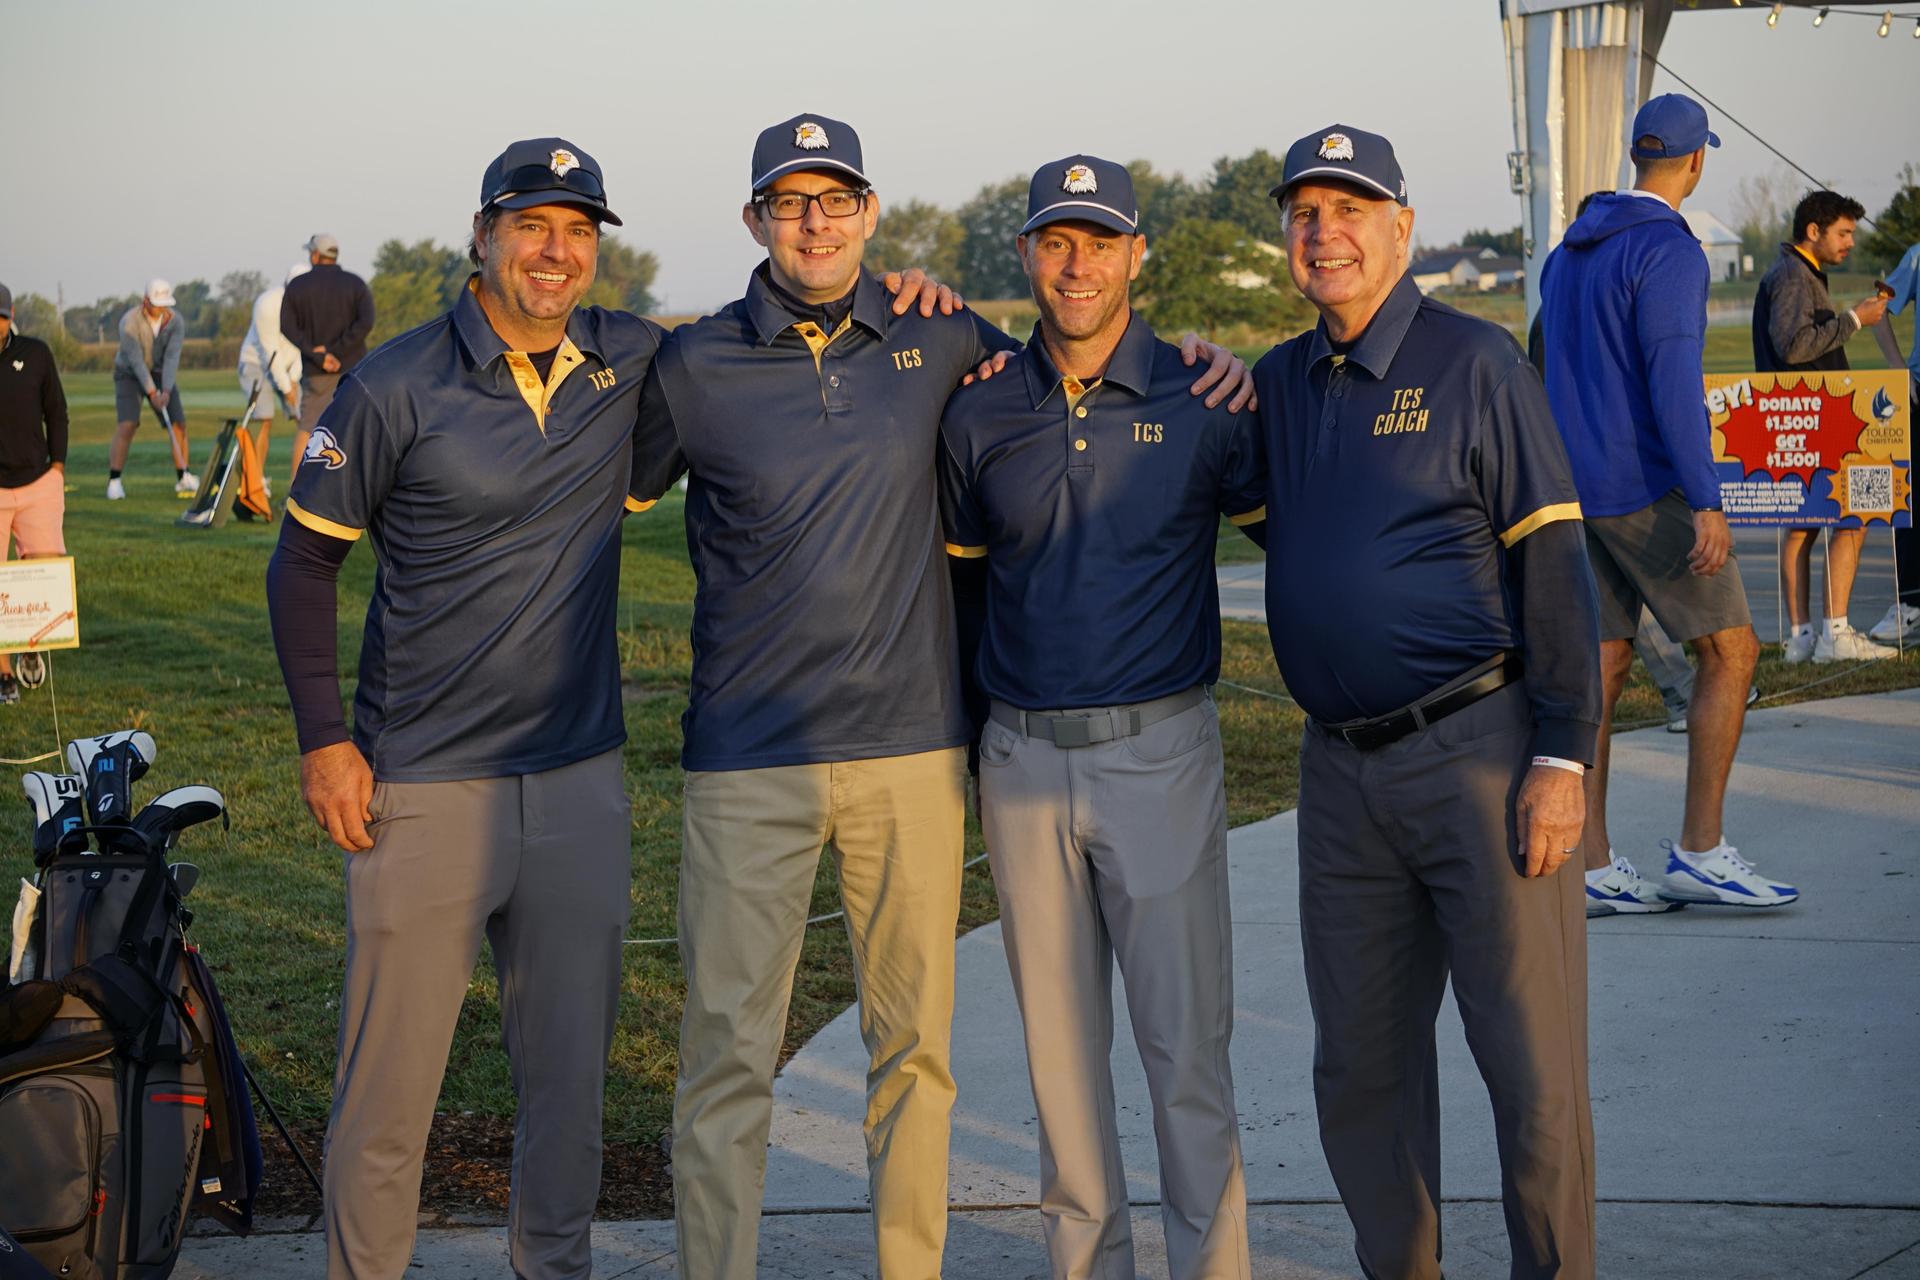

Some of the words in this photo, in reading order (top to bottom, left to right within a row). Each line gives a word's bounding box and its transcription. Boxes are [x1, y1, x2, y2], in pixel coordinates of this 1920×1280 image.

[891, 348, 922, 370] TCS
[588, 368, 616, 391] TCS
[1392, 387, 1424, 411] TCS
[1704, 379, 1755, 414] EY!
[1759, 396, 1822, 413] DONATE
[1132, 422, 1163, 443] TCS
[1373, 409, 1429, 436] COACH
[1765, 415, 1820, 432] $1,500!
[1866, 428, 1904, 437] TOLEDO
[1776, 434, 1806, 449] GET
[1766, 452, 1820, 468] $1,500!
